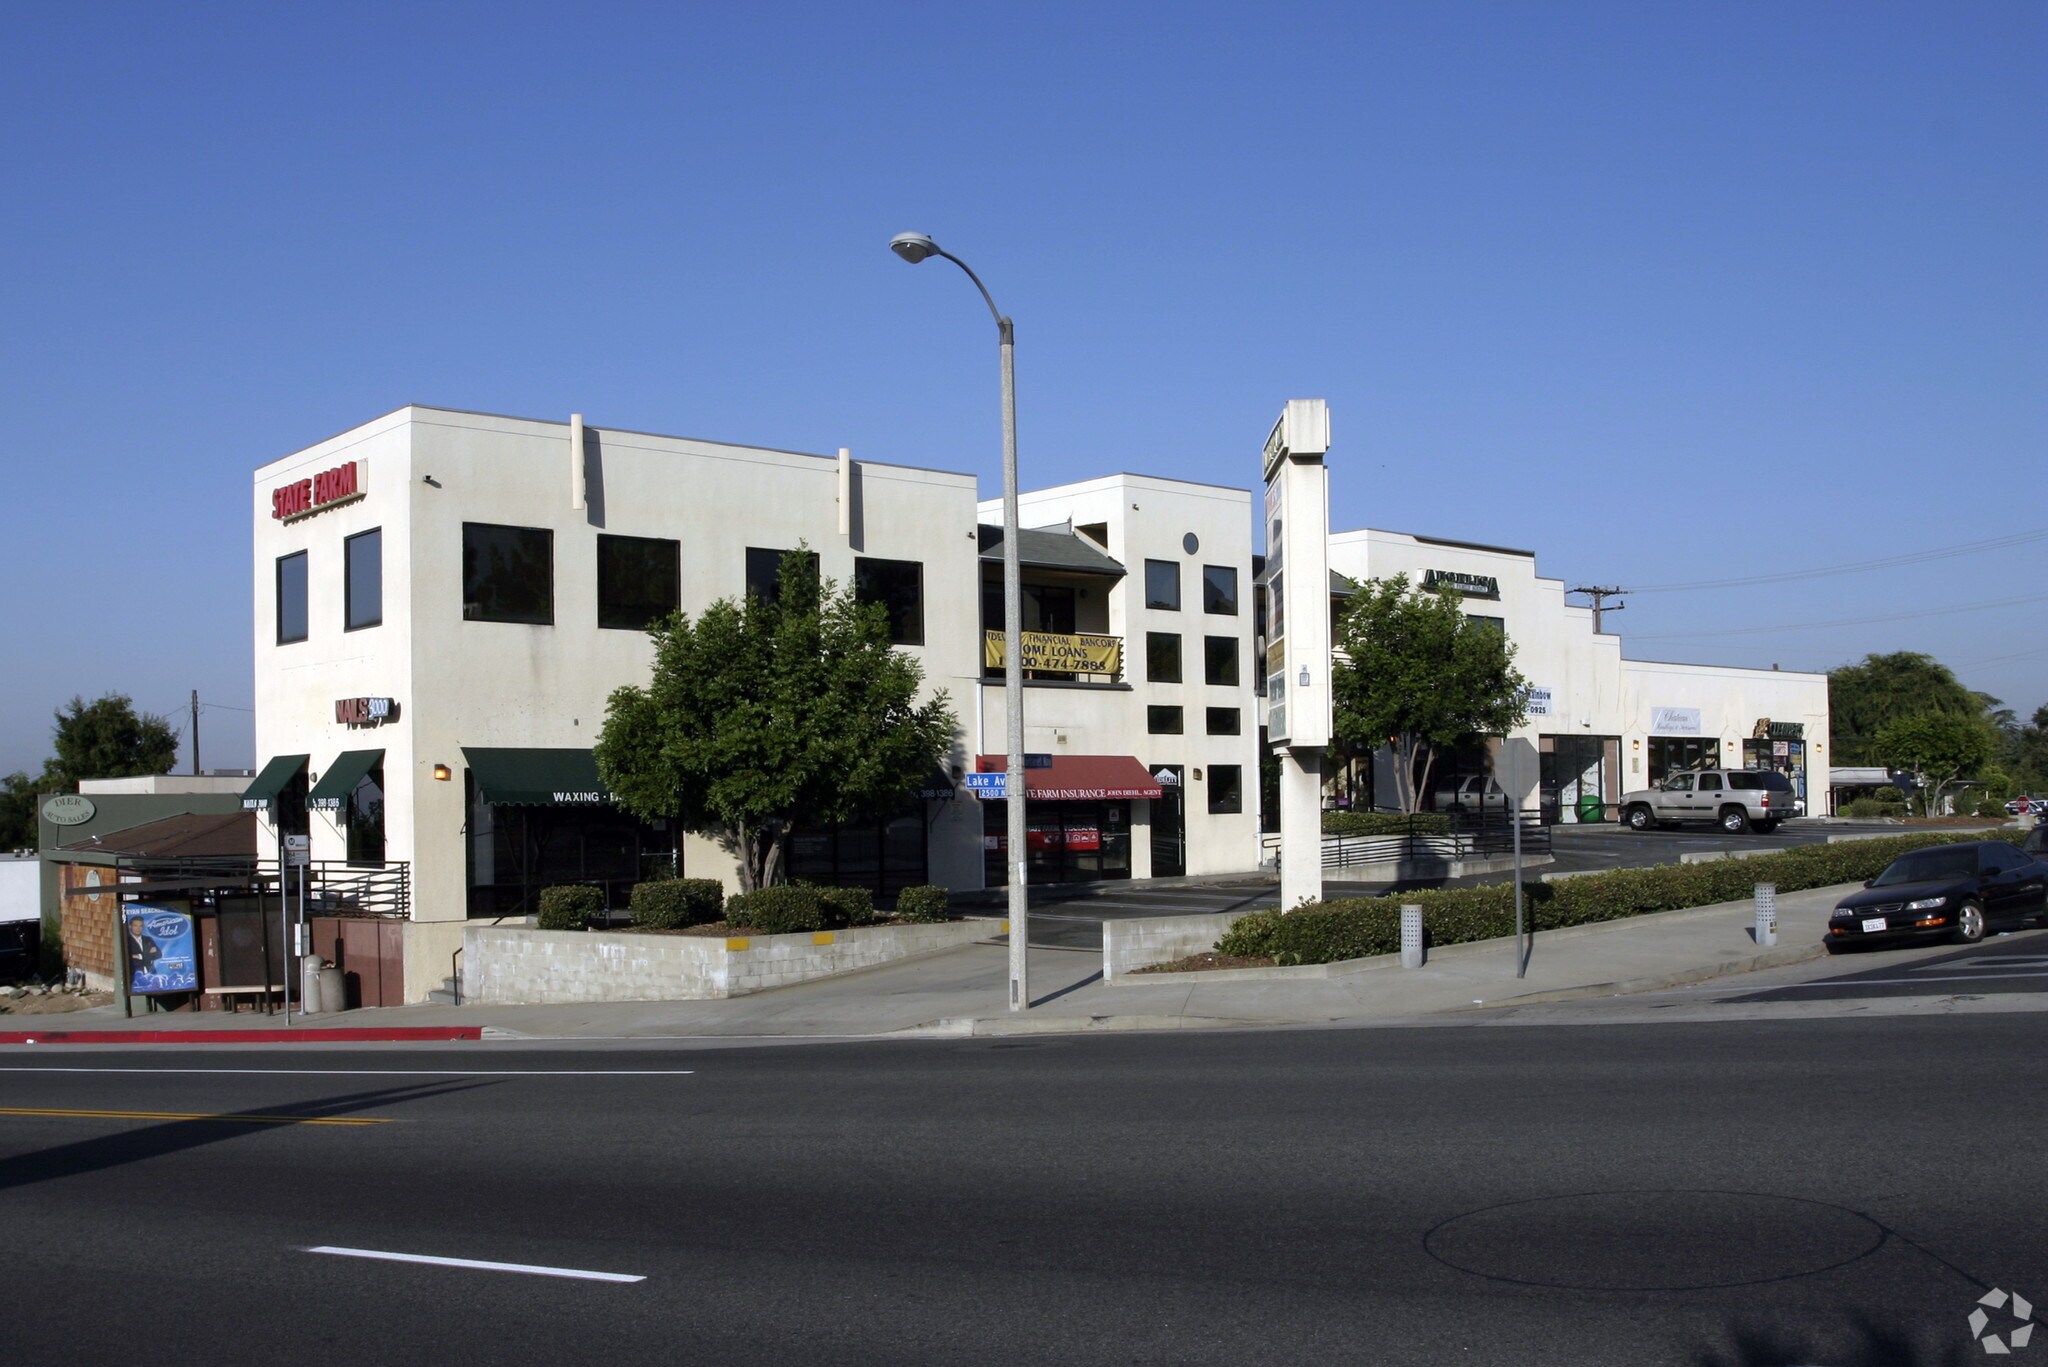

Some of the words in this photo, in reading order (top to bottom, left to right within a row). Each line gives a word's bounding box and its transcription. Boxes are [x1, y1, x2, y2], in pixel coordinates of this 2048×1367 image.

[272, 478, 312, 520] STATE
[313, 461, 358, 505] FARM
[1029, 634, 1070, 645] FINANCIAL
[1080, 637, 1117, 648] BANCORP
[1022, 644, 1047, 656] OME
[1051, 646, 1088, 659] LOANS
[335, 698, 368, 724] NAILS
[368, 698, 390, 721] 3000
[967, 775, 989, 786] Lake
[994, 775, 1006, 786] Av
[553, 791, 600, 802] WAXING
[981, 789, 999, 797] 2500
[1037, 788, 1060, 799] FARM
[1060, 788, 1107, 799] INSURANCE
[146, 916, 184, 929] American
[158, 925, 179, 937] Idol
